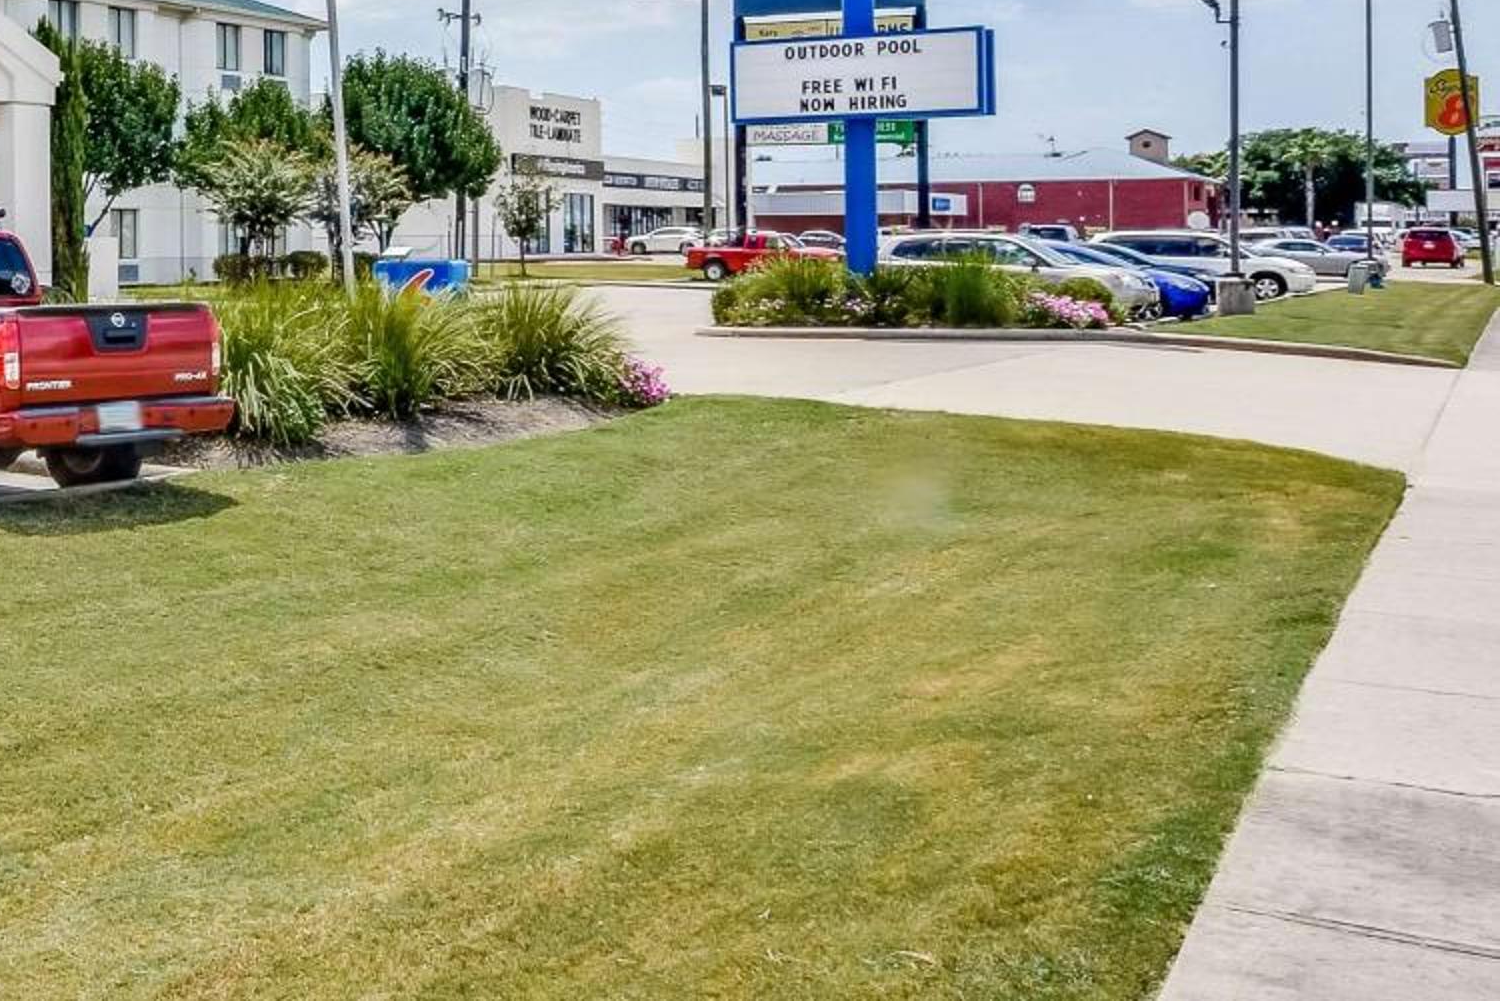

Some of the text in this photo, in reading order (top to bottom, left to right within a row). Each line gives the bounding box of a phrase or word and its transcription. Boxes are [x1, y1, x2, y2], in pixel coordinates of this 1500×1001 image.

[785, 39, 921, 60] OUTDOOR POOL
[802, 79, 843, 95] FREE
[800, 94, 908, 113] NOW HIRING
[752, 130, 821, 142] MASSAGE
[26, 380, 71, 392] FRONTIER
